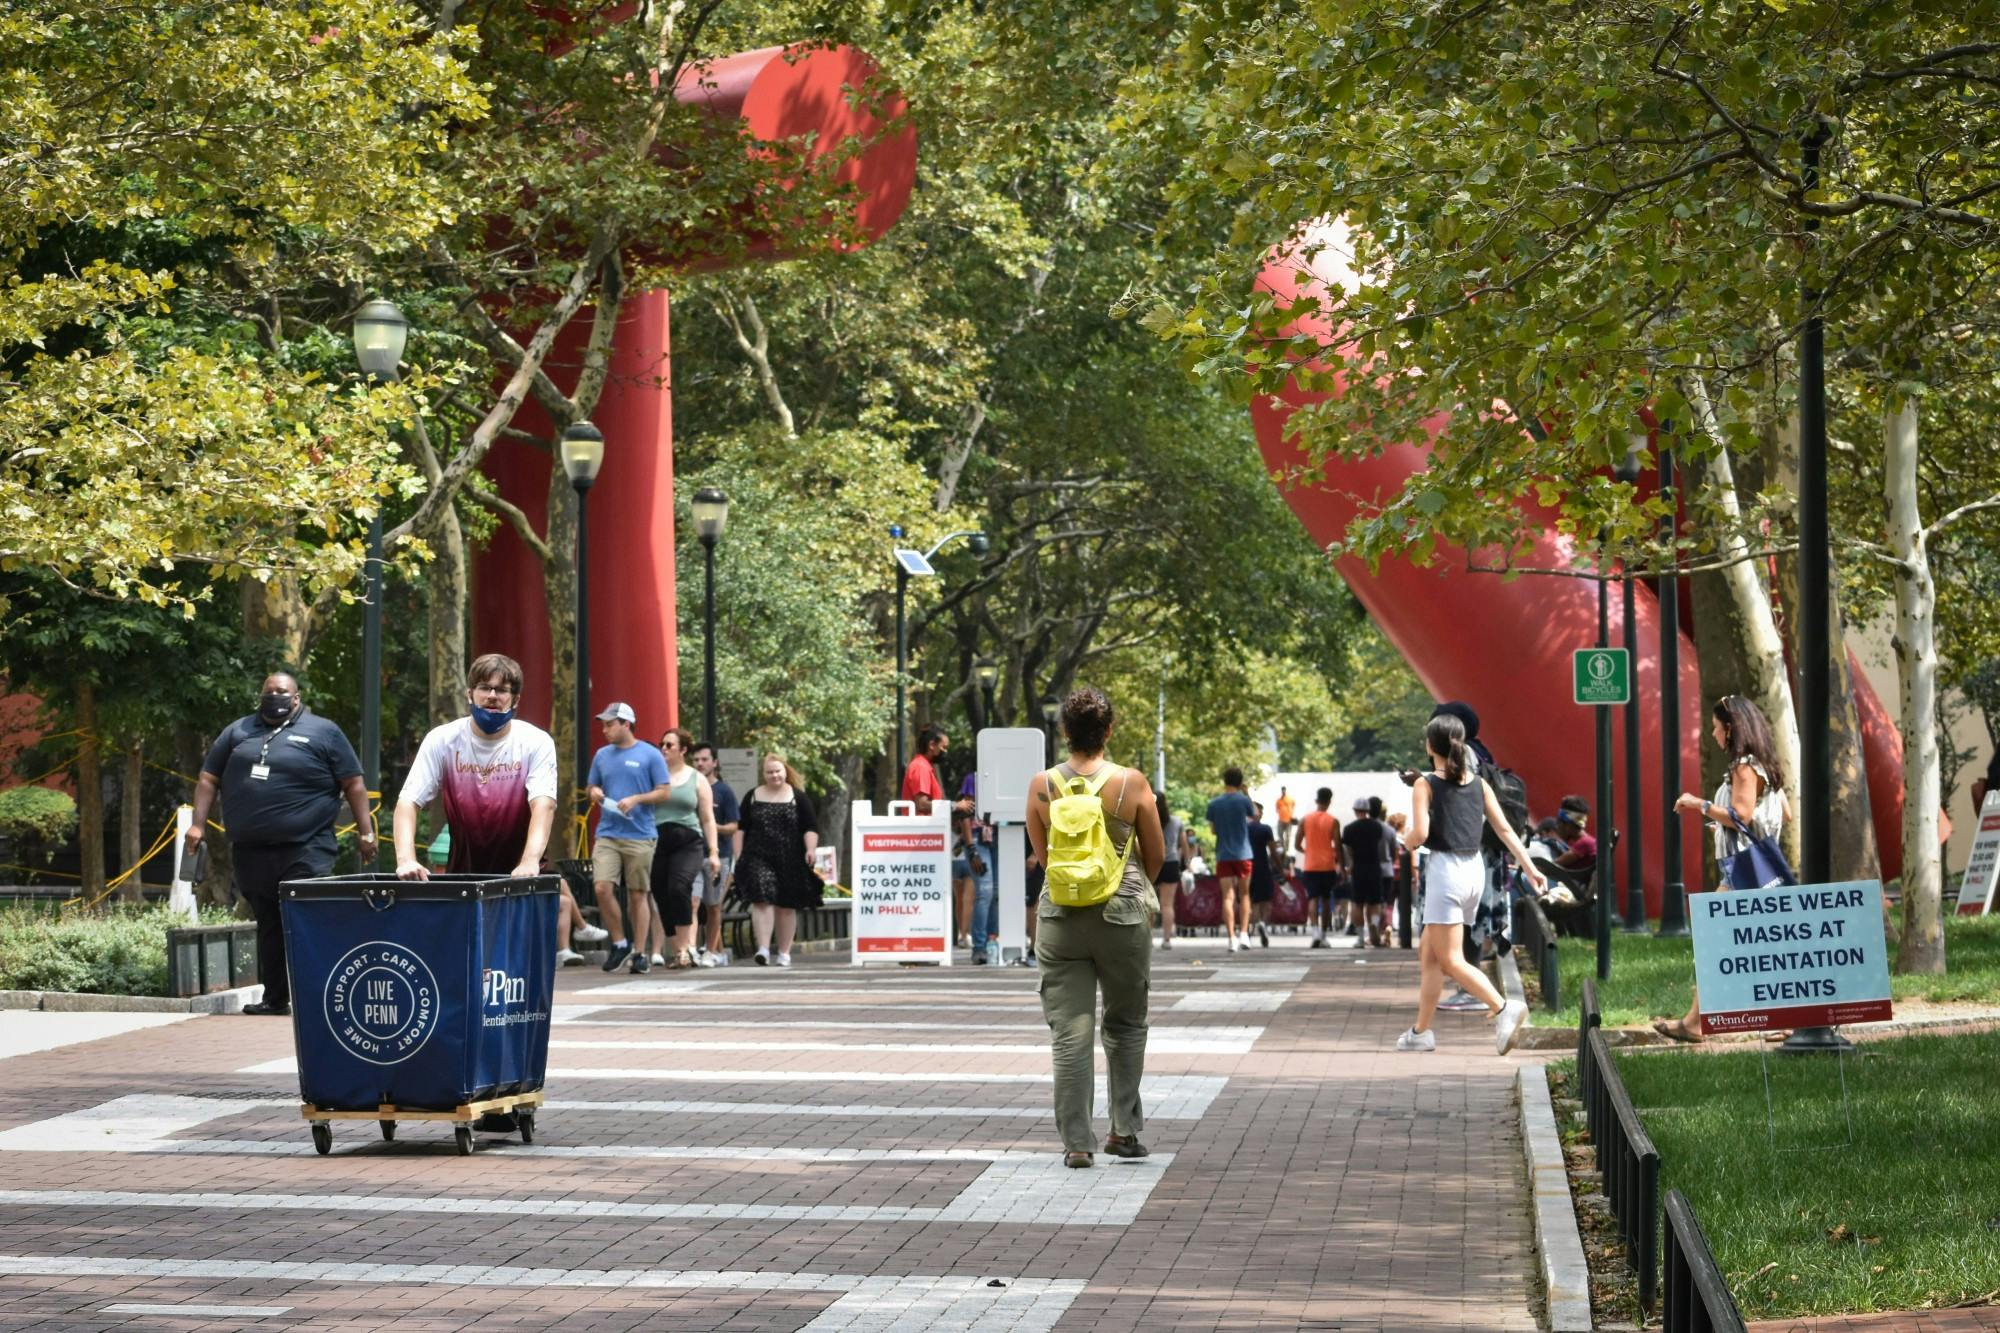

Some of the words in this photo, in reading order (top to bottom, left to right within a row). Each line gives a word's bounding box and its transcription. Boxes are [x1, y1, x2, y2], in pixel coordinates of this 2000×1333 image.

[1582, 686, 1621, 694] BICYCLES
[1591, 679, 1612, 687] WALK
[867, 839, 943, 847] VISITPHILLY.COM
[860, 864, 886, 874] FOR
[890, 864, 937, 874] WHERE
[861, 878, 877, 888] TO
[881, 878, 900, 888] GO
[904, 878, 932, 888] AND
[860, 891, 897, 901] WHAT
[902, 891, 918, 901] TO
[922, 891, 941, 901] DO
[1708, 895, 1793, 918] PLEASE
[1797, 889, 1865, 911] WEAR
[860, 905, 874, 915] IN
[878, 905, 922, 915] PHILLY.
[1733, 923, 1813, 945] MASKS
[1819, 919, 1846, 938] AT
[381, 952, 417, 975] CARE
[1719, 947, 1865, 975] ORIENTATION
[334, 954, 368, 1013] SUPPORT
[367, 980, 394, 1000] LIVE
[1753, 979, 1836, 1002] EVENTS
[364, 1004, 398, 1024] PENN
[396, 987, 431, 1051] COMFORT
[1716, 1014, 1741, 1026] Penn
[1741, 1013, 1769, 1024] Cares
[344, 1025, 380, 1054] HOME
